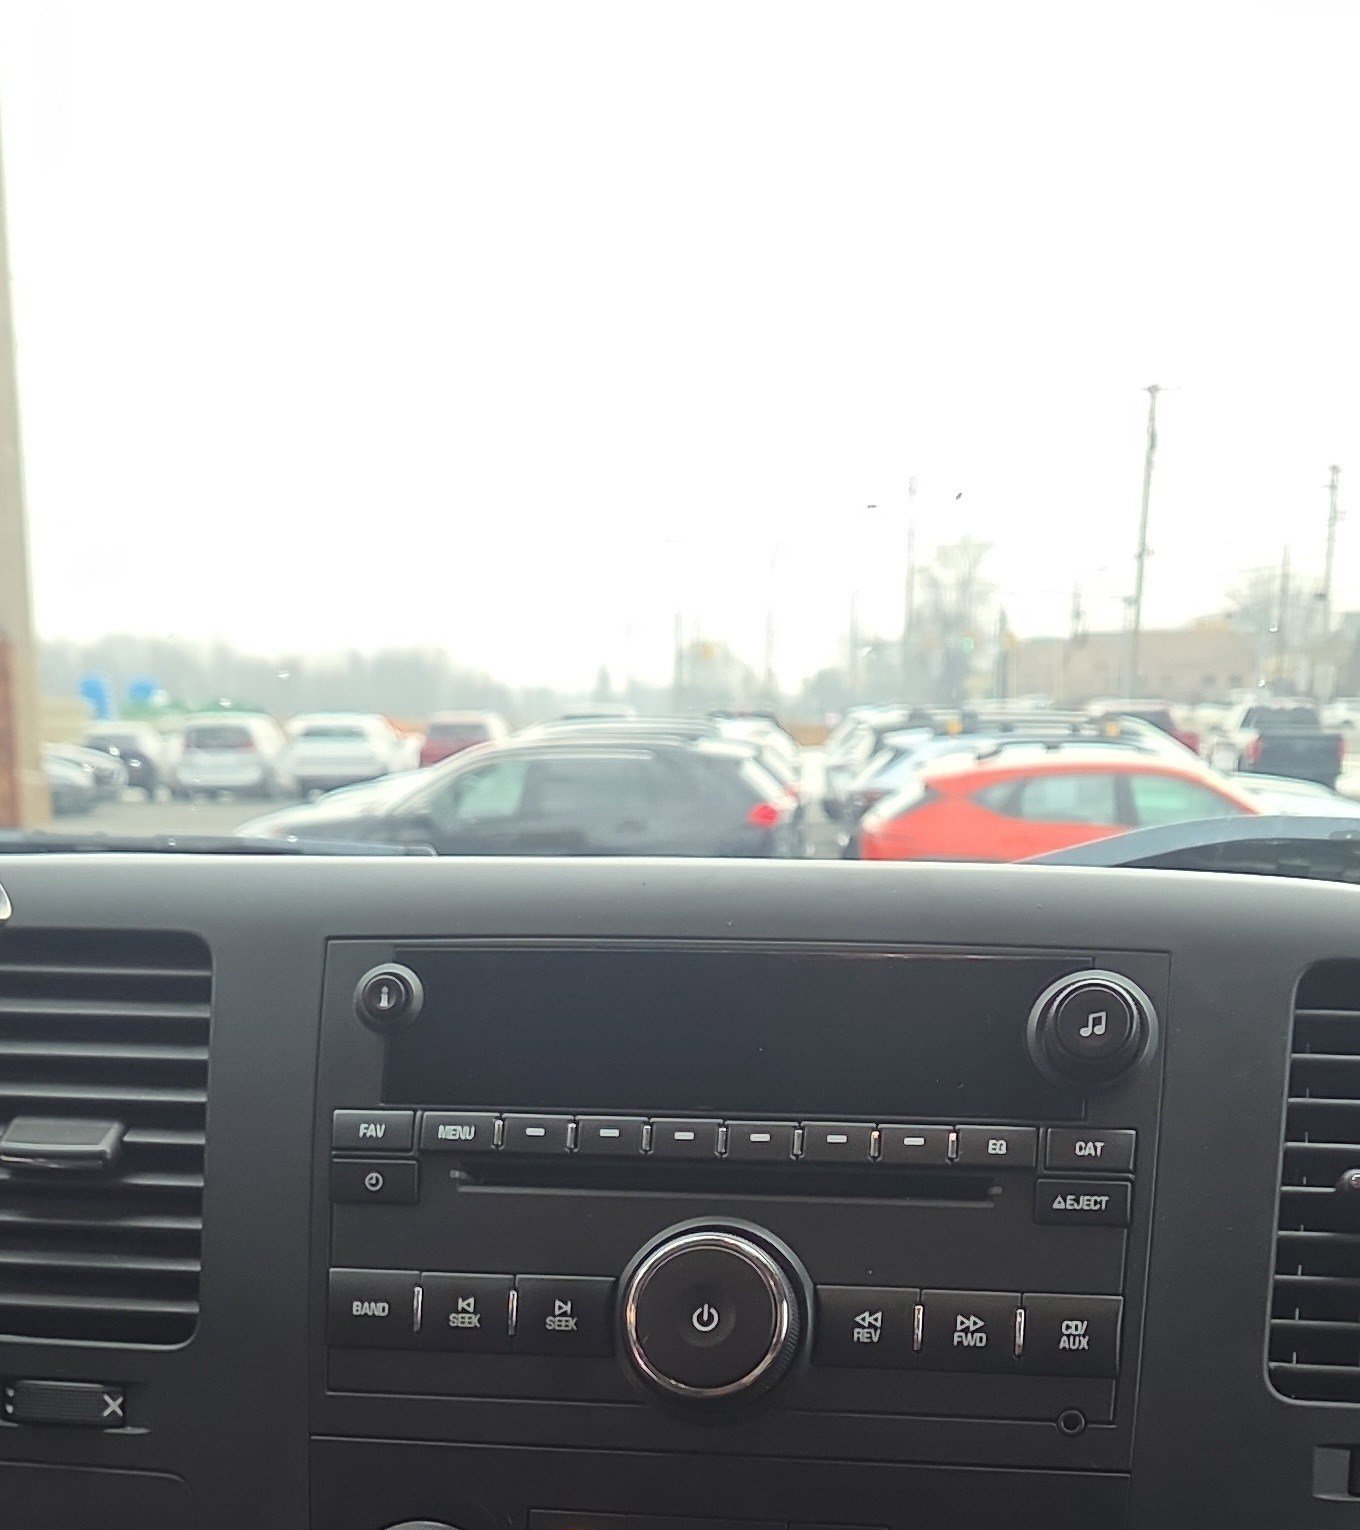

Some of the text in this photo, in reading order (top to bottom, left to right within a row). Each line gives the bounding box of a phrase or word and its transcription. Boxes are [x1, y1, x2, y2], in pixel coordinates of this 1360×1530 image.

[358, 1123, 386, 1139] FAV
[437, 1124, 475, 1140] MENU
[987, 1139, 1007, 1155] EQ
[1074, 1141, 1105, 1157] CAT
[1065, 1194, 1110, 1211] EJECT
[352, 1300, 389, 1317] BAND
[448, 1313, 481, 1328] SEEK
[545, 1316, 578, 1331] SEEK
[1061, 1320, 1088, 1335] CD/
[853, 1328, 882, 1343] REV
[953, 1332, 987, 1347] FWD
[1058, 1335, 1090, 1350] AUX
